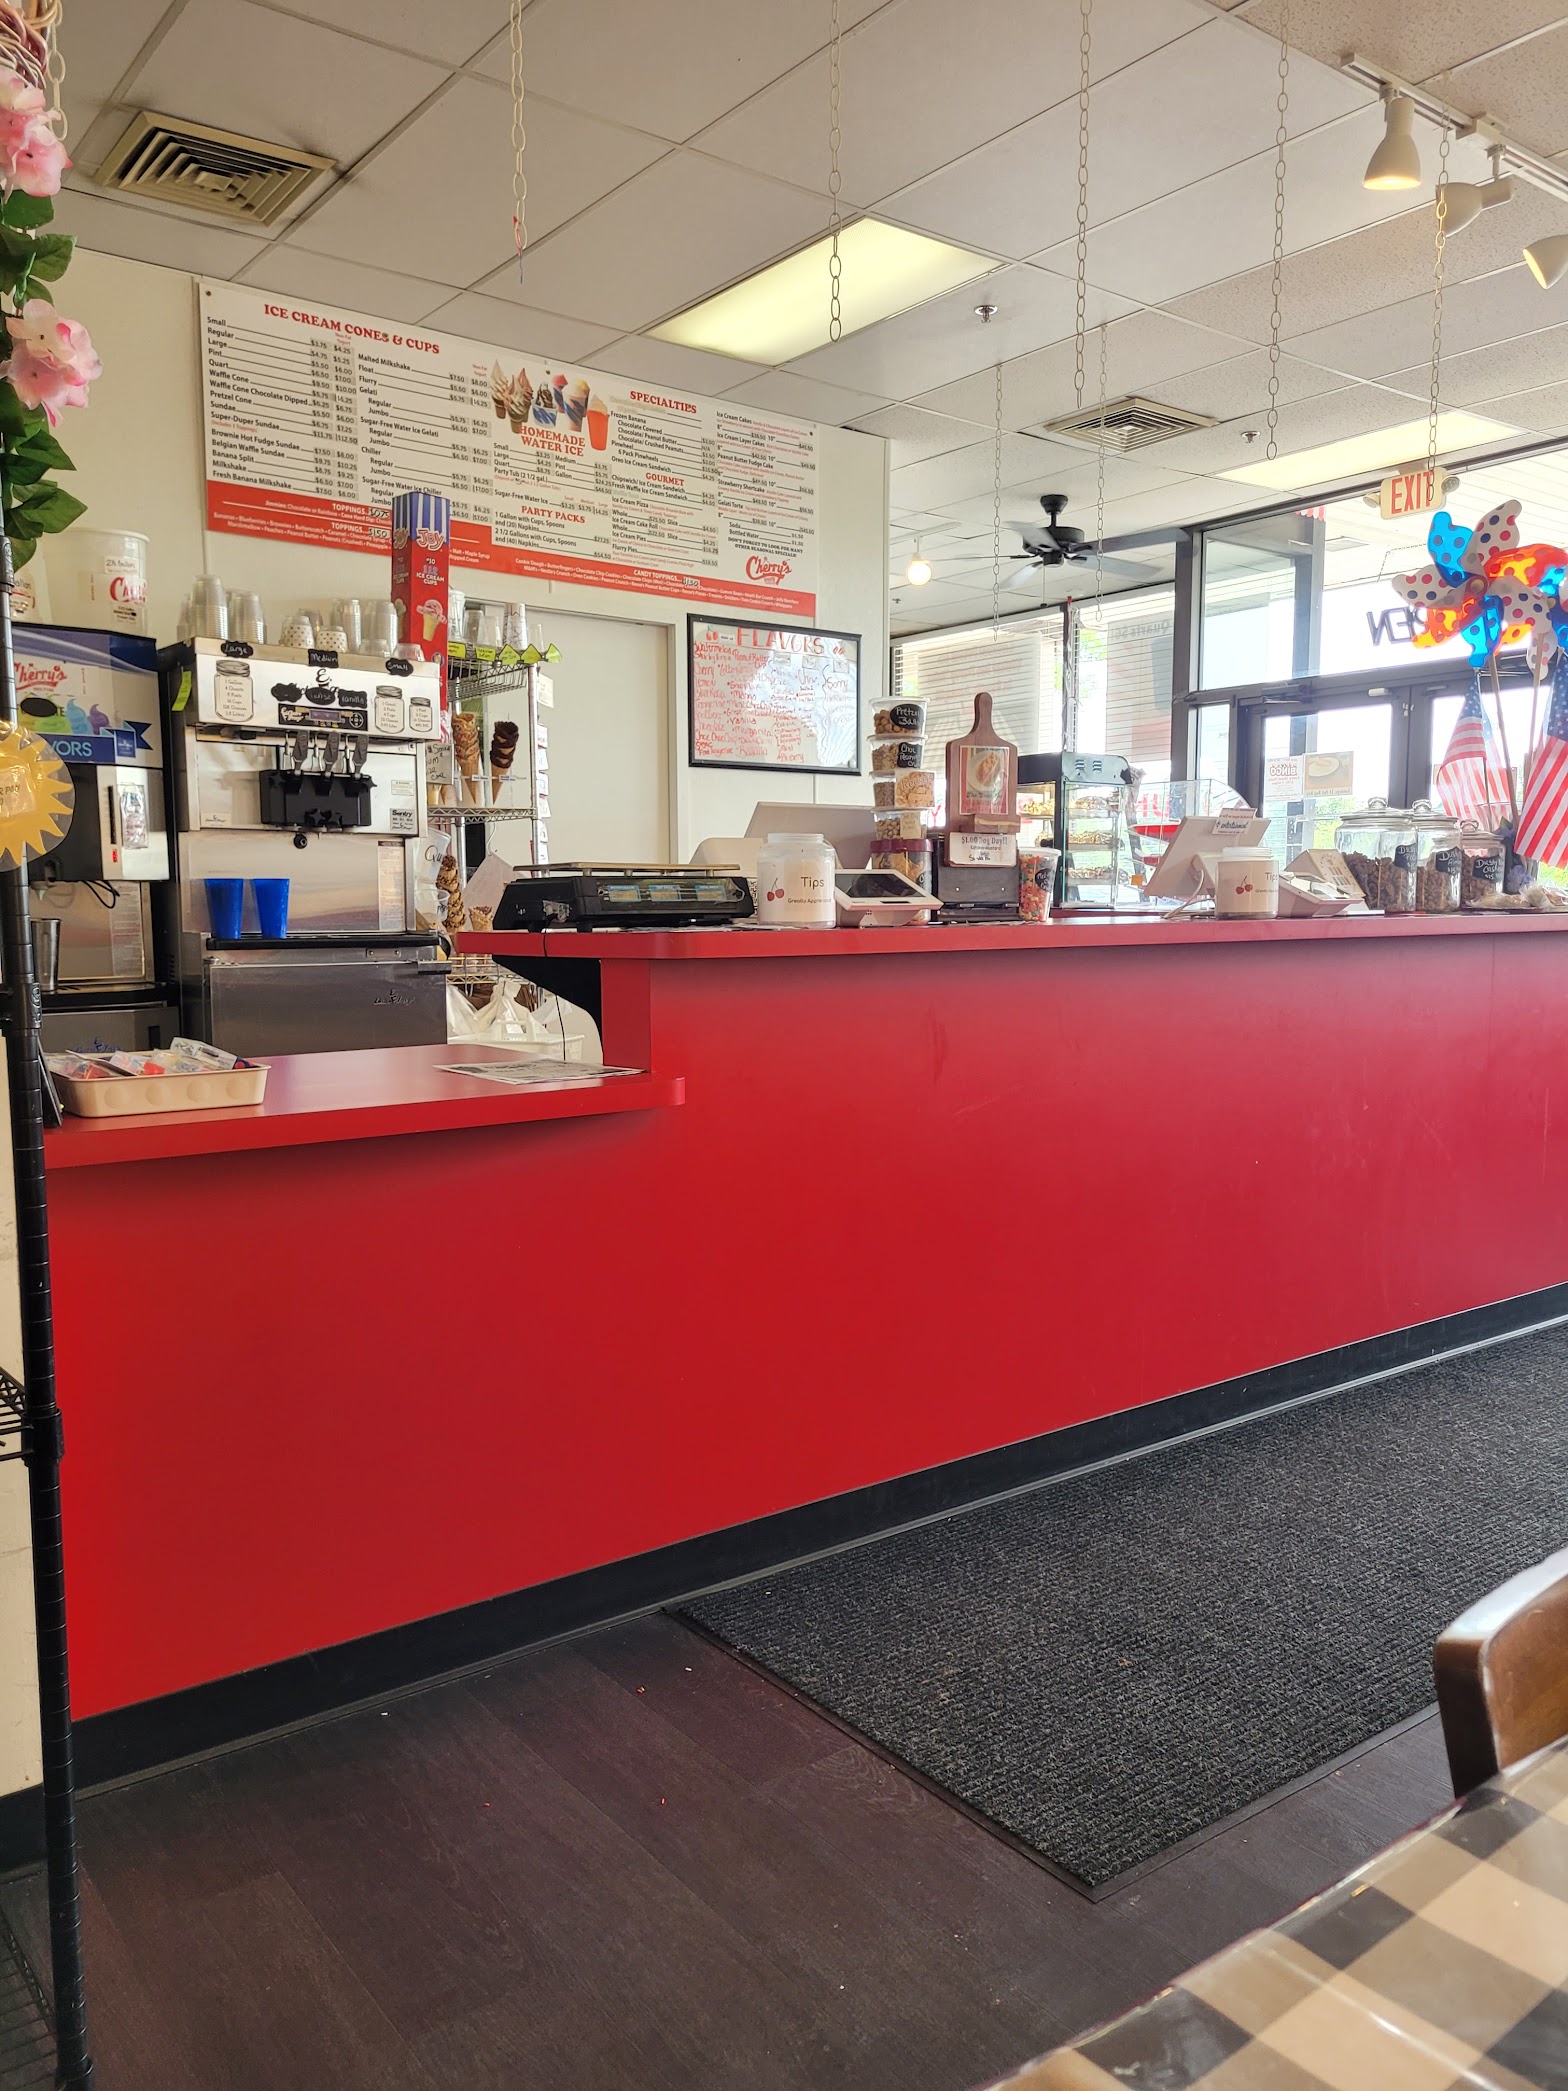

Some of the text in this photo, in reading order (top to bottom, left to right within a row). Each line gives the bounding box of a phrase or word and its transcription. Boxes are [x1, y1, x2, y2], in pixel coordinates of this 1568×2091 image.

[207, 316, 226, 327] Small
[207, 327, 234, 339] Regular
[264, 304, 288, 319] ICE
[292, 311, 341, 332] CREAM
[344, 324, 389, 342] CONES
[392, 335, 403, 345] &
[406, 338, 440, 354] CUPS
[208, 337, 228, 348] Large
[208, 348, 222, 357] Pint
[209, 358, 229, 369] Quart
[358, 353, 411, 371] Malted Milkshake
[358, 364, 374, 373] Float
[209, 369, 249, 383] Waffle Cone
[359, 375, 377, 386] Flurry
[209, 379, 308, 406] Waffle Cone Chocolate Dipped
[210, 390, 252, 405] Pretzel Cone
[359, 387, 378, 396] Gelati
[210, 401, 236, 411] Sundae
[368, 398, 392, 408] Regular
[630, 390, 697, 414] SPECIALTIES
[368, 407, 390, 417] Jumbo
[610, 411, 646, 424] Frozen Banana
[211, 411, 254, 425] Super-Duper
[255, 419, 280, 430] Sundae
[724, 413, 738, 421] Cream
[739, 416, 752, 424] Cakes
[360, 416, 439, 438] Sugar-Free Water Ice Gelati
[369, 428, 393, 438] Regular
[618, 420, 662, 435] Chocolate Covered
[211, 428, 300, 450] Brownie Hot Fudge Sundae
[369, 437, 391, 447] Jumbo
[520, 425, 586, 447] HOMEMADE
[212, 439, 285, 458] Belgian Waffle Sundae
[521, 436, 584, 457] WATER ICE
[611, 440, 634, 449] Pinwheel
[212, 449, 255, 463] Banana Split
[361, 447, 381, 456] Chiller
[494, 451, 509, 460] Large
[212, 460, 247, 471] Milkshake
[370, 457, 394, 468] Regular
[555, 455, 576, 464] Medium
[370, 467, 391, 477] Jumbo
[494, 459, 573, 480] Quart Gallon
[494, 467, 509, 477] Party
[632, 460, 647, 468] Cream
[648, 463, 672, 473] Sandwich
[213, 470, 292, 490] Fresh Banana Milkshake
[362, 476, 442, 495] Sugar-Free Water Ice Chiller
[645, 472, 685, 487] GOURMET
[370, 487, 394, 497] Regular
[663, 484, 685, 494] Sandwich
[1391, 470, 1435, 516] EXIT
[371, 497, 391, 506] Jumbo
[494, 490, 524, 500] Sugar-Free
[525, 494, 540, 503] Water
[521, 505, 586, 523] PARTY PACKS
[500, 512, 517, 521] Gallon
[518, 514, 530, 523] with
[545, 519, 565, 529] Spoons
[518, 523, 540, 532] Napkins
[509, 529, 529, 540] Gallons
[530, 533, 542, 541] with
[557, 538, 577, 547] Spoons
[518, 539, 540, 548] Napkins
[746, 555, 792, 585] Cherry's
[736, 626, 825, 655] FLAVORS
[224, 643, 248, 655] Large
[311, 653, 338, 662] Medium
[14, 662, 67, 690] herry's
[392, 810, 413, 818] Sentry
[961, 836, 978, 845] $1.00
[979, 837, 990, 845] Dog
[801, 877, 825, 890] Tips
